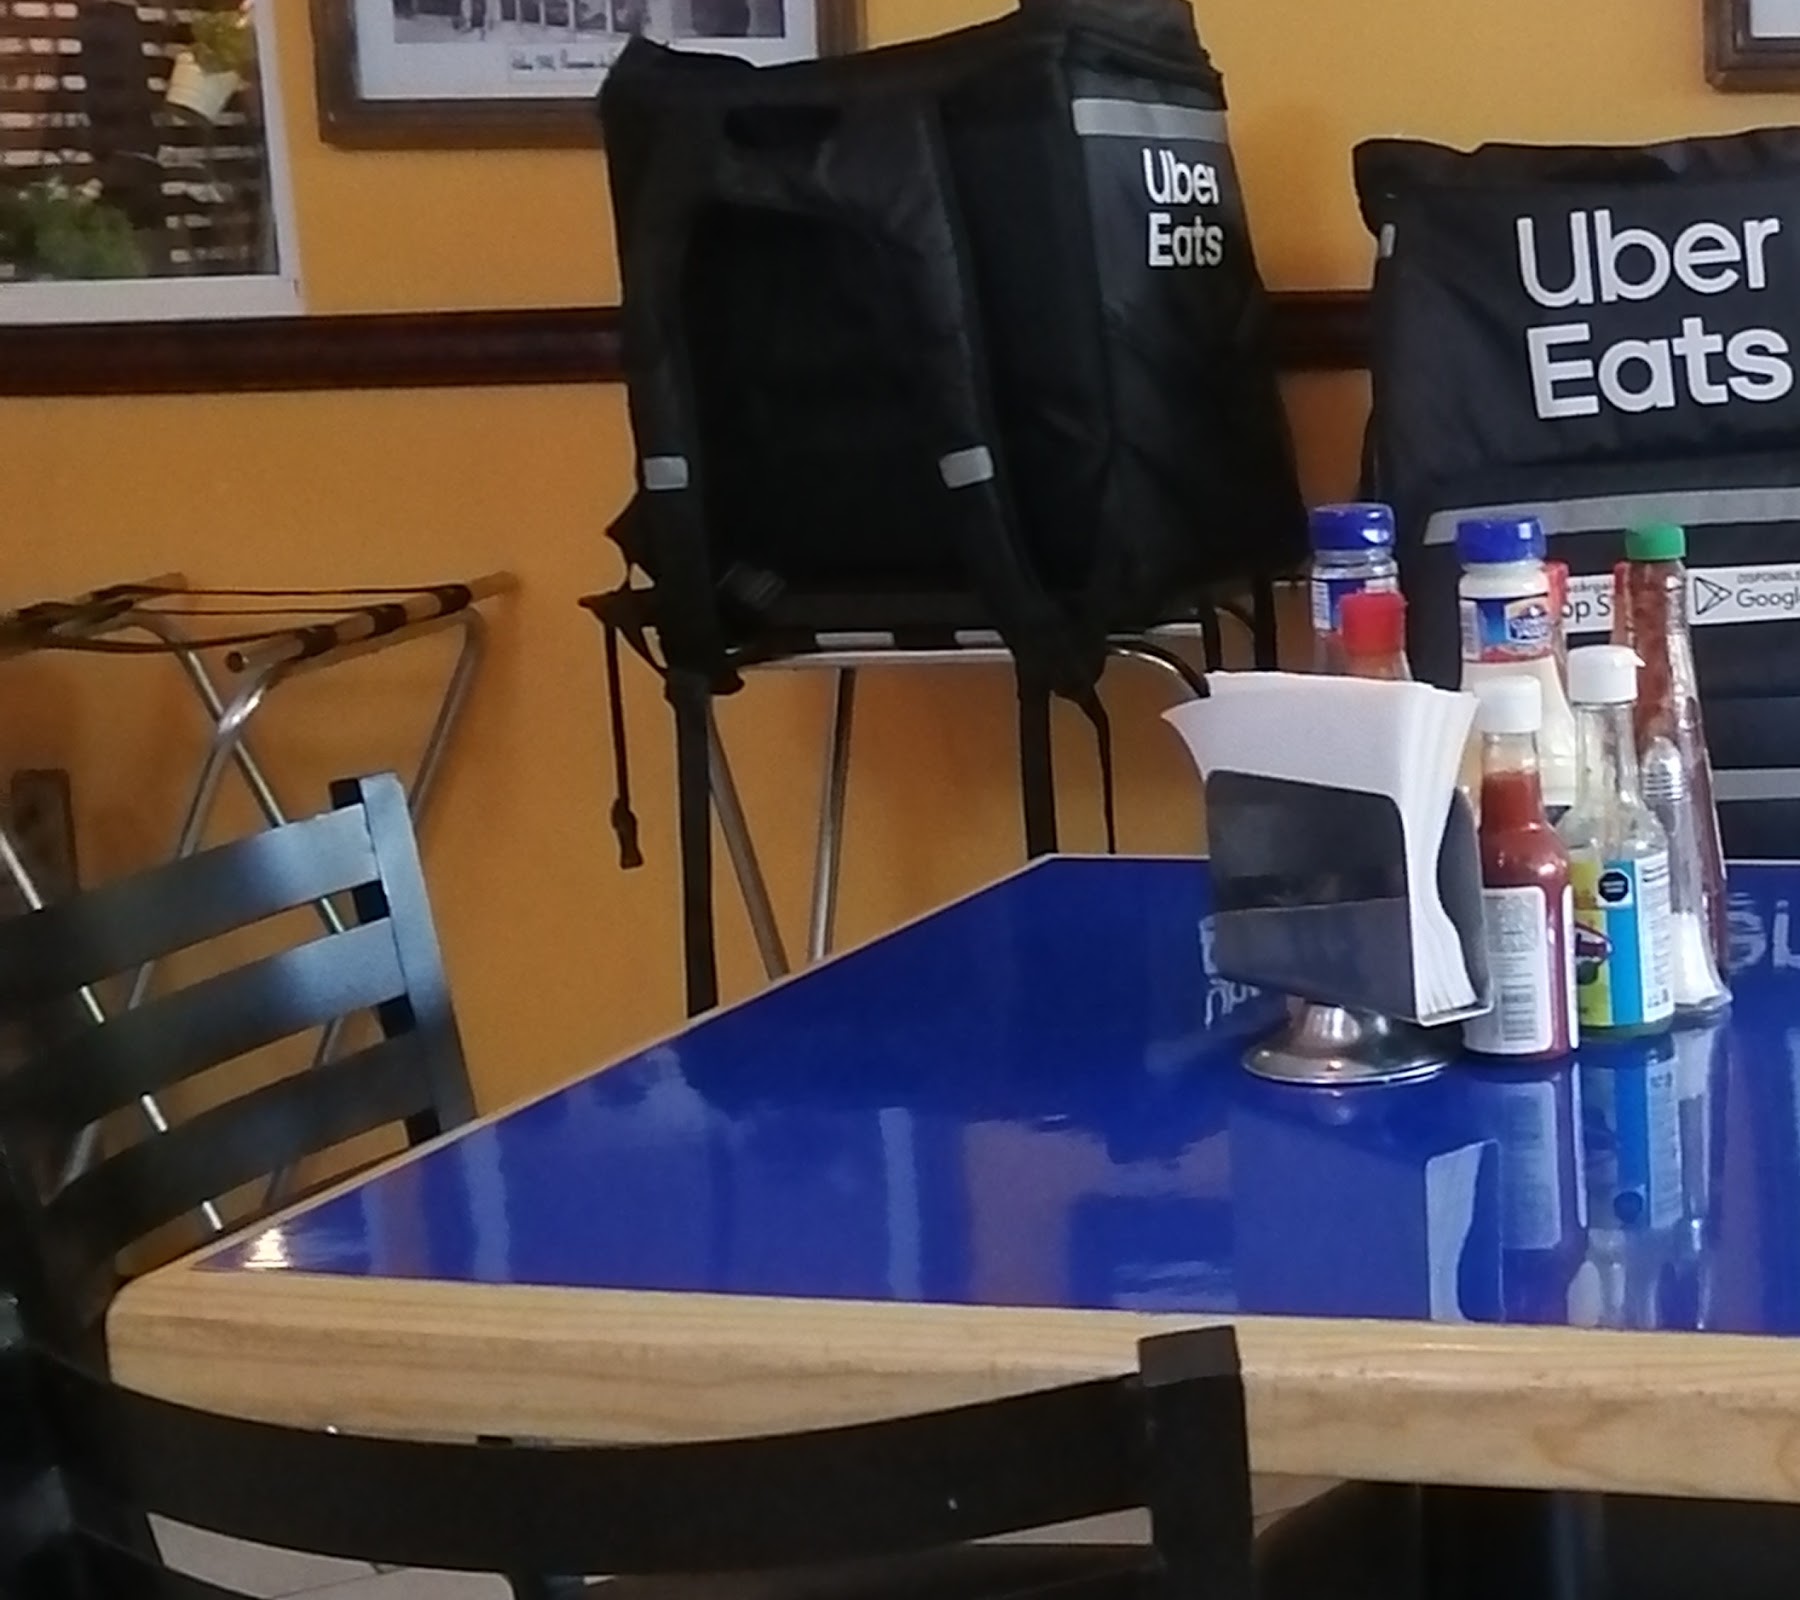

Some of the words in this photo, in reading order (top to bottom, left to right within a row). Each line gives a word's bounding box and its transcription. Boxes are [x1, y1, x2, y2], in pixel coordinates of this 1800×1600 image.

[1148, 211, 1224, 267] Eats
[1516, 208, 1781, 308] Uber
[1526, 317, 1794, 420] Eats
